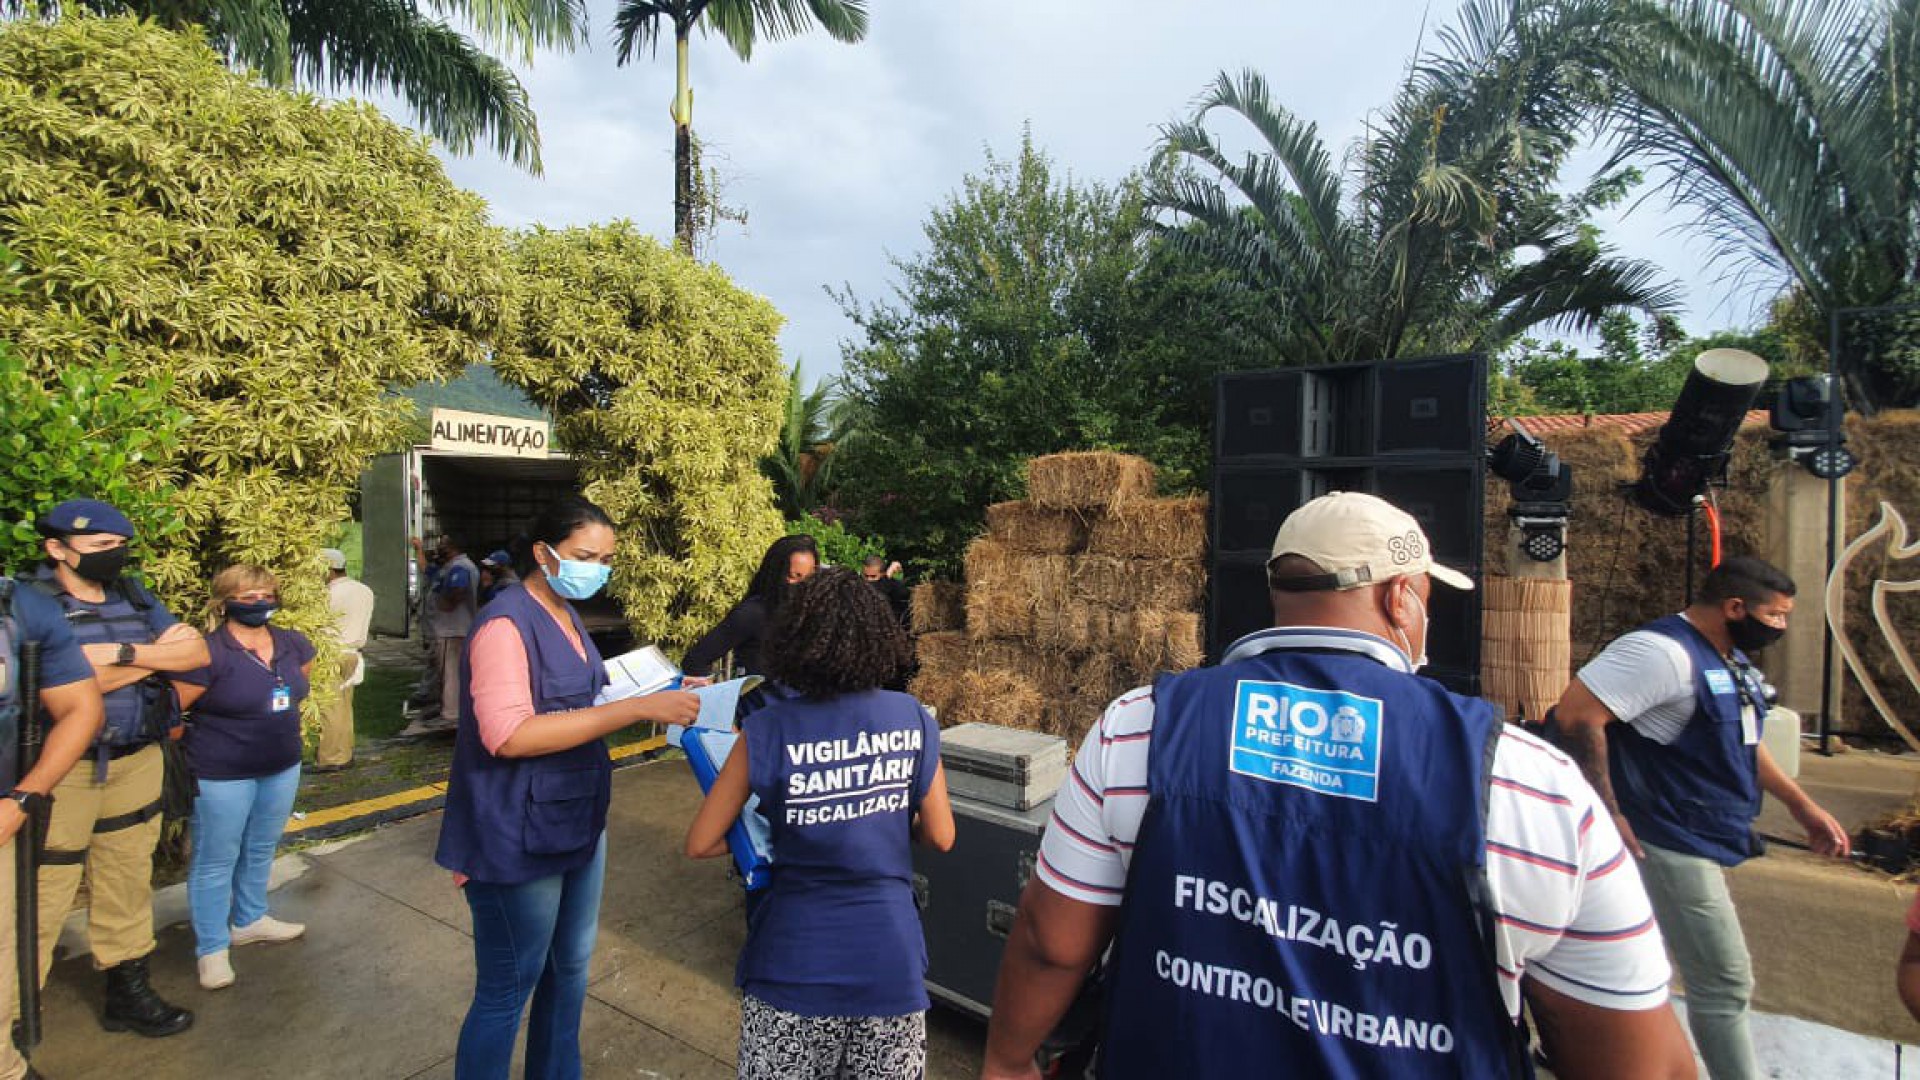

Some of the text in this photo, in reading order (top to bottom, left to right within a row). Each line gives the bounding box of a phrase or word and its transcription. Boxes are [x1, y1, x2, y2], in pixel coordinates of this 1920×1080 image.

[433, 420, 545, 454] ALIMENTAÇÃO
[1388, 530, 1424, 565] 88
[1247, 692, 1328, 736] RIO
[786, 729, 921, 765] VIGILÂNCIA
[1245, 726, 1364, 761] PREFEITURA
[1271, 761, 1343, 788] FAZENDA
[1174, 874, 1432, 971] FISCALIZAÇÃO
[1155, 950, 1310, 1031] CONTROLE
